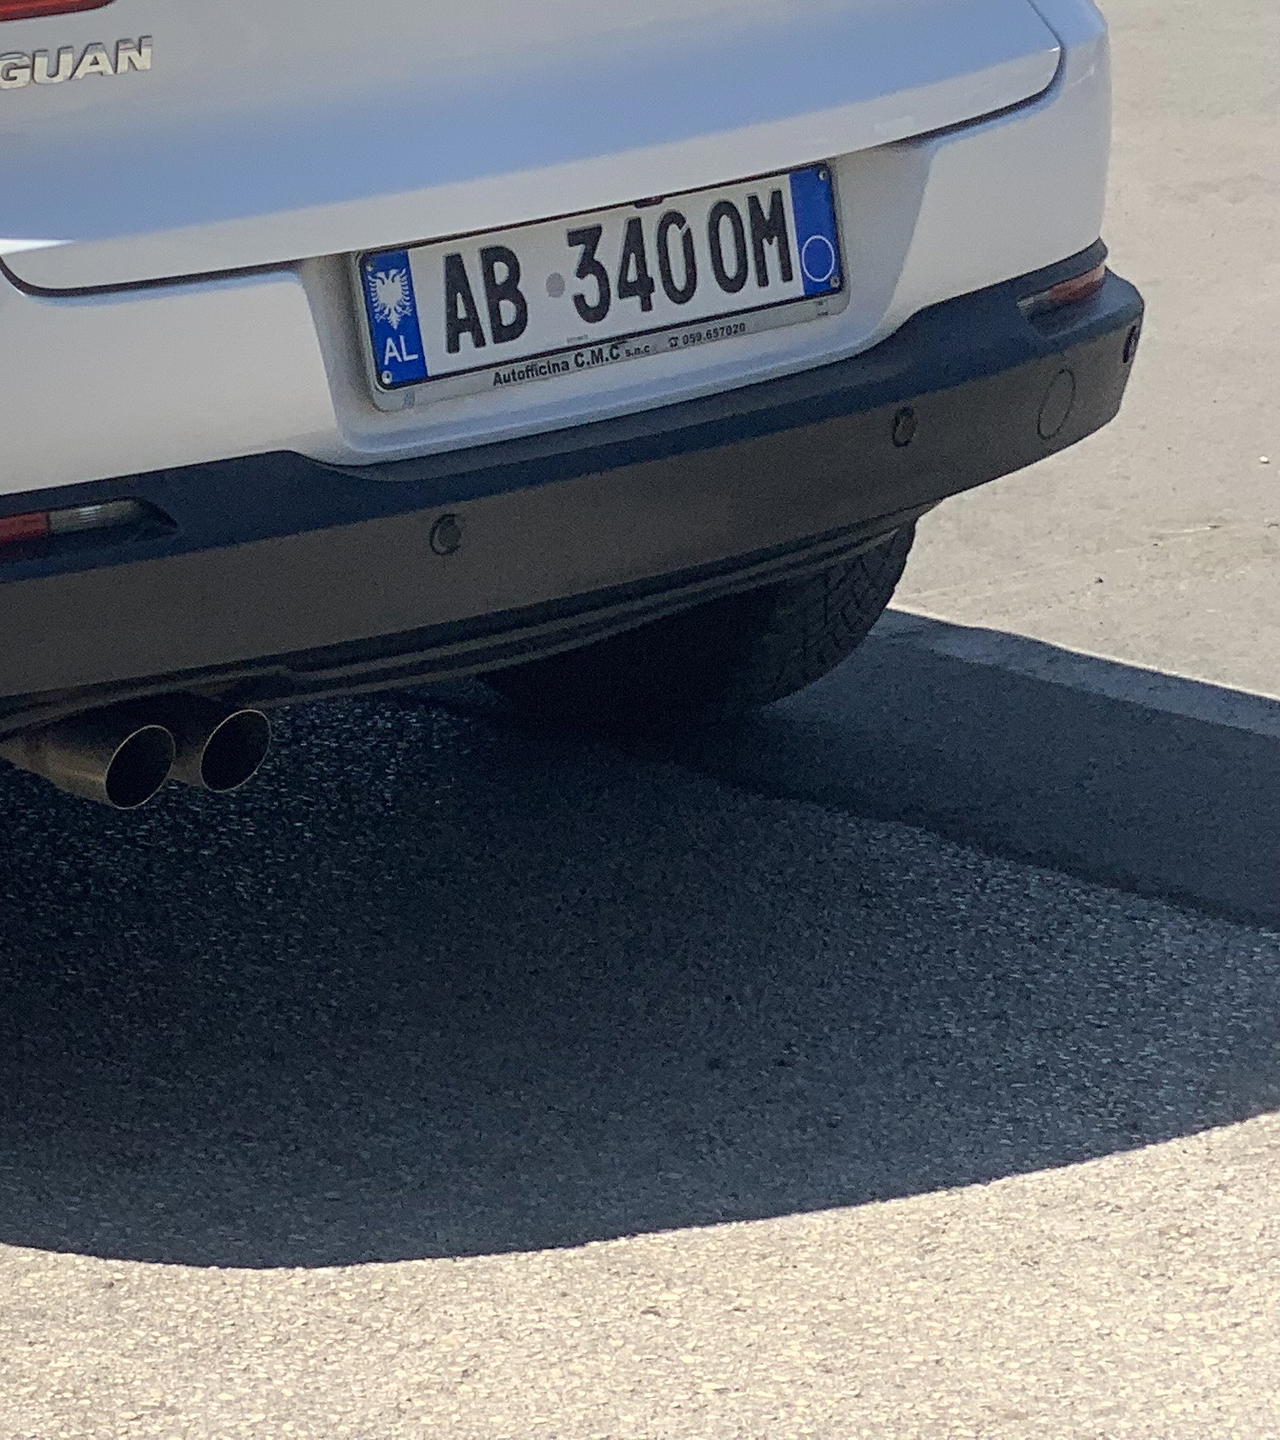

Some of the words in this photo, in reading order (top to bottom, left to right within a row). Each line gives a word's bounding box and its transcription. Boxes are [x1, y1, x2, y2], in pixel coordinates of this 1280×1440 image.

[443, 245, 528, 354] AB
[384, 334, 419, 366] AL
[493, 359, 570, 387] Autofficina
